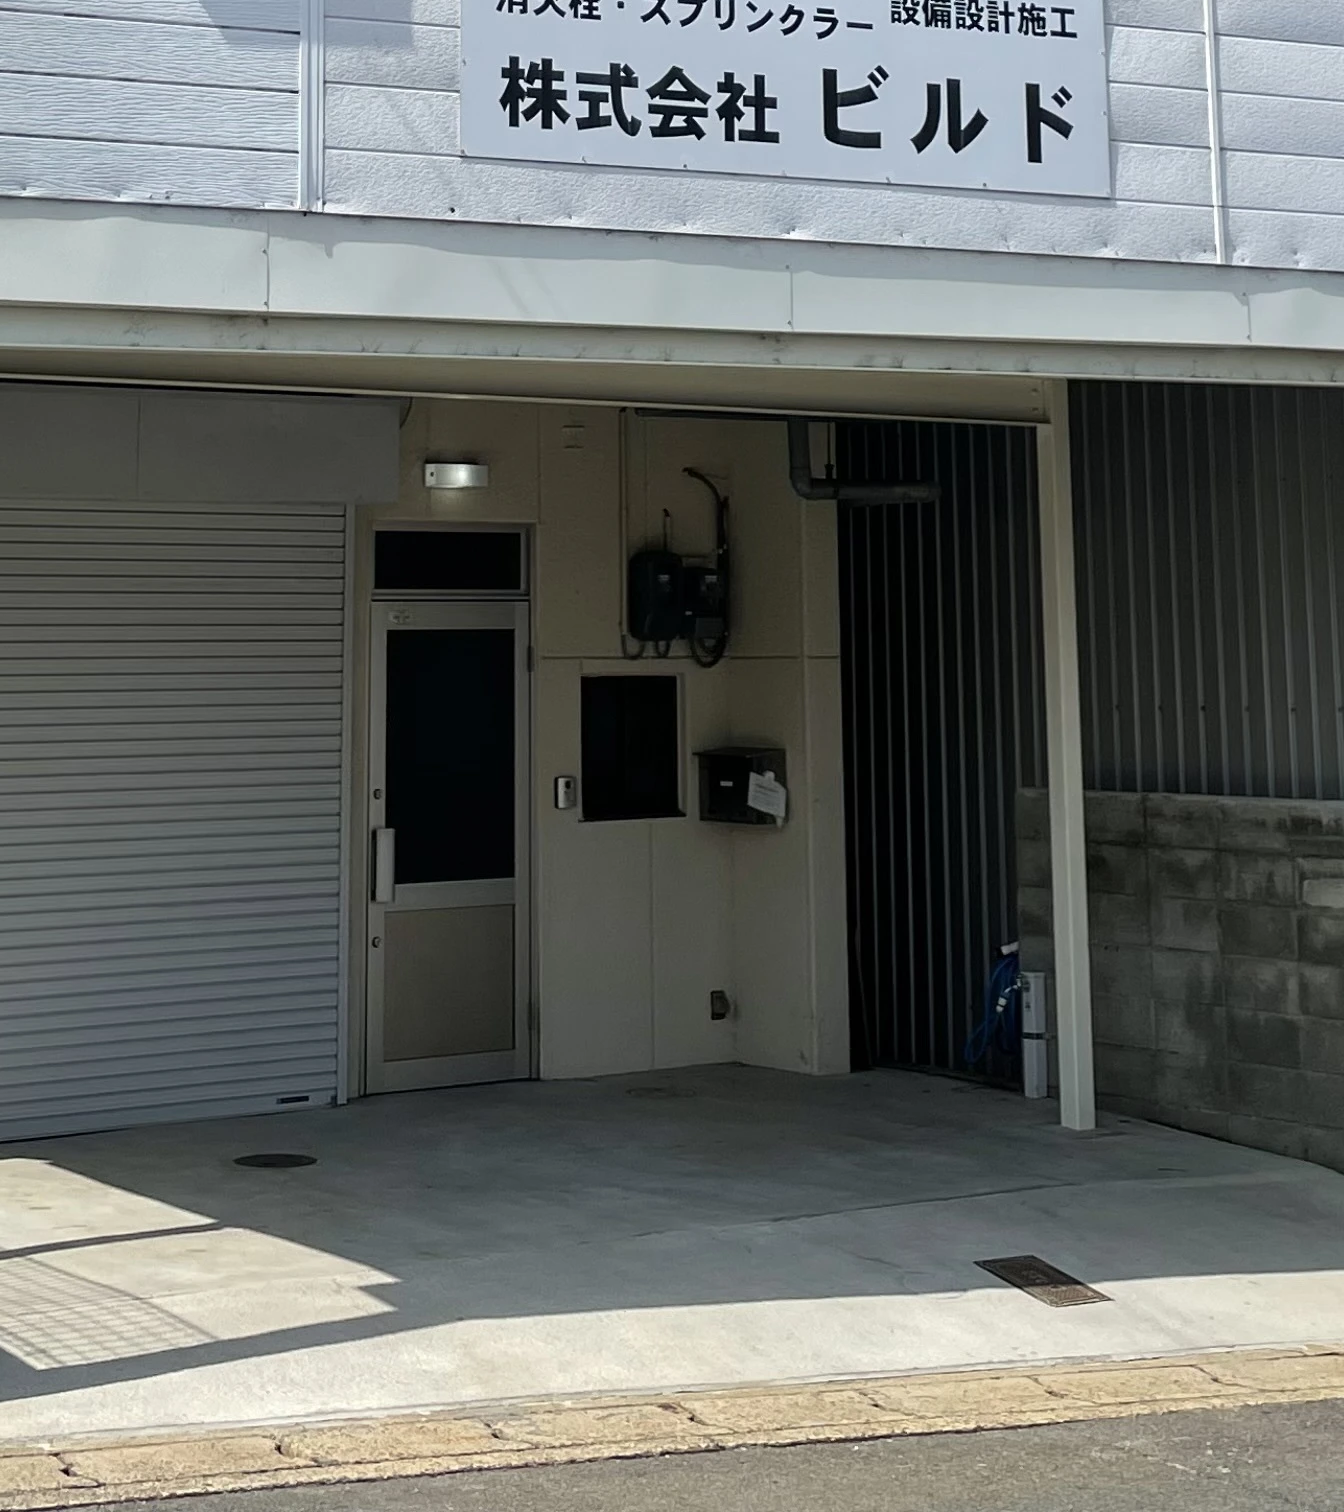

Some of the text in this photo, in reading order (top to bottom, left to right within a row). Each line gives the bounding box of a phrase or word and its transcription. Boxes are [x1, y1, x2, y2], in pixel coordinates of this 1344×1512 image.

[499, 56, 1074, 164] 株式会社 ビルド
